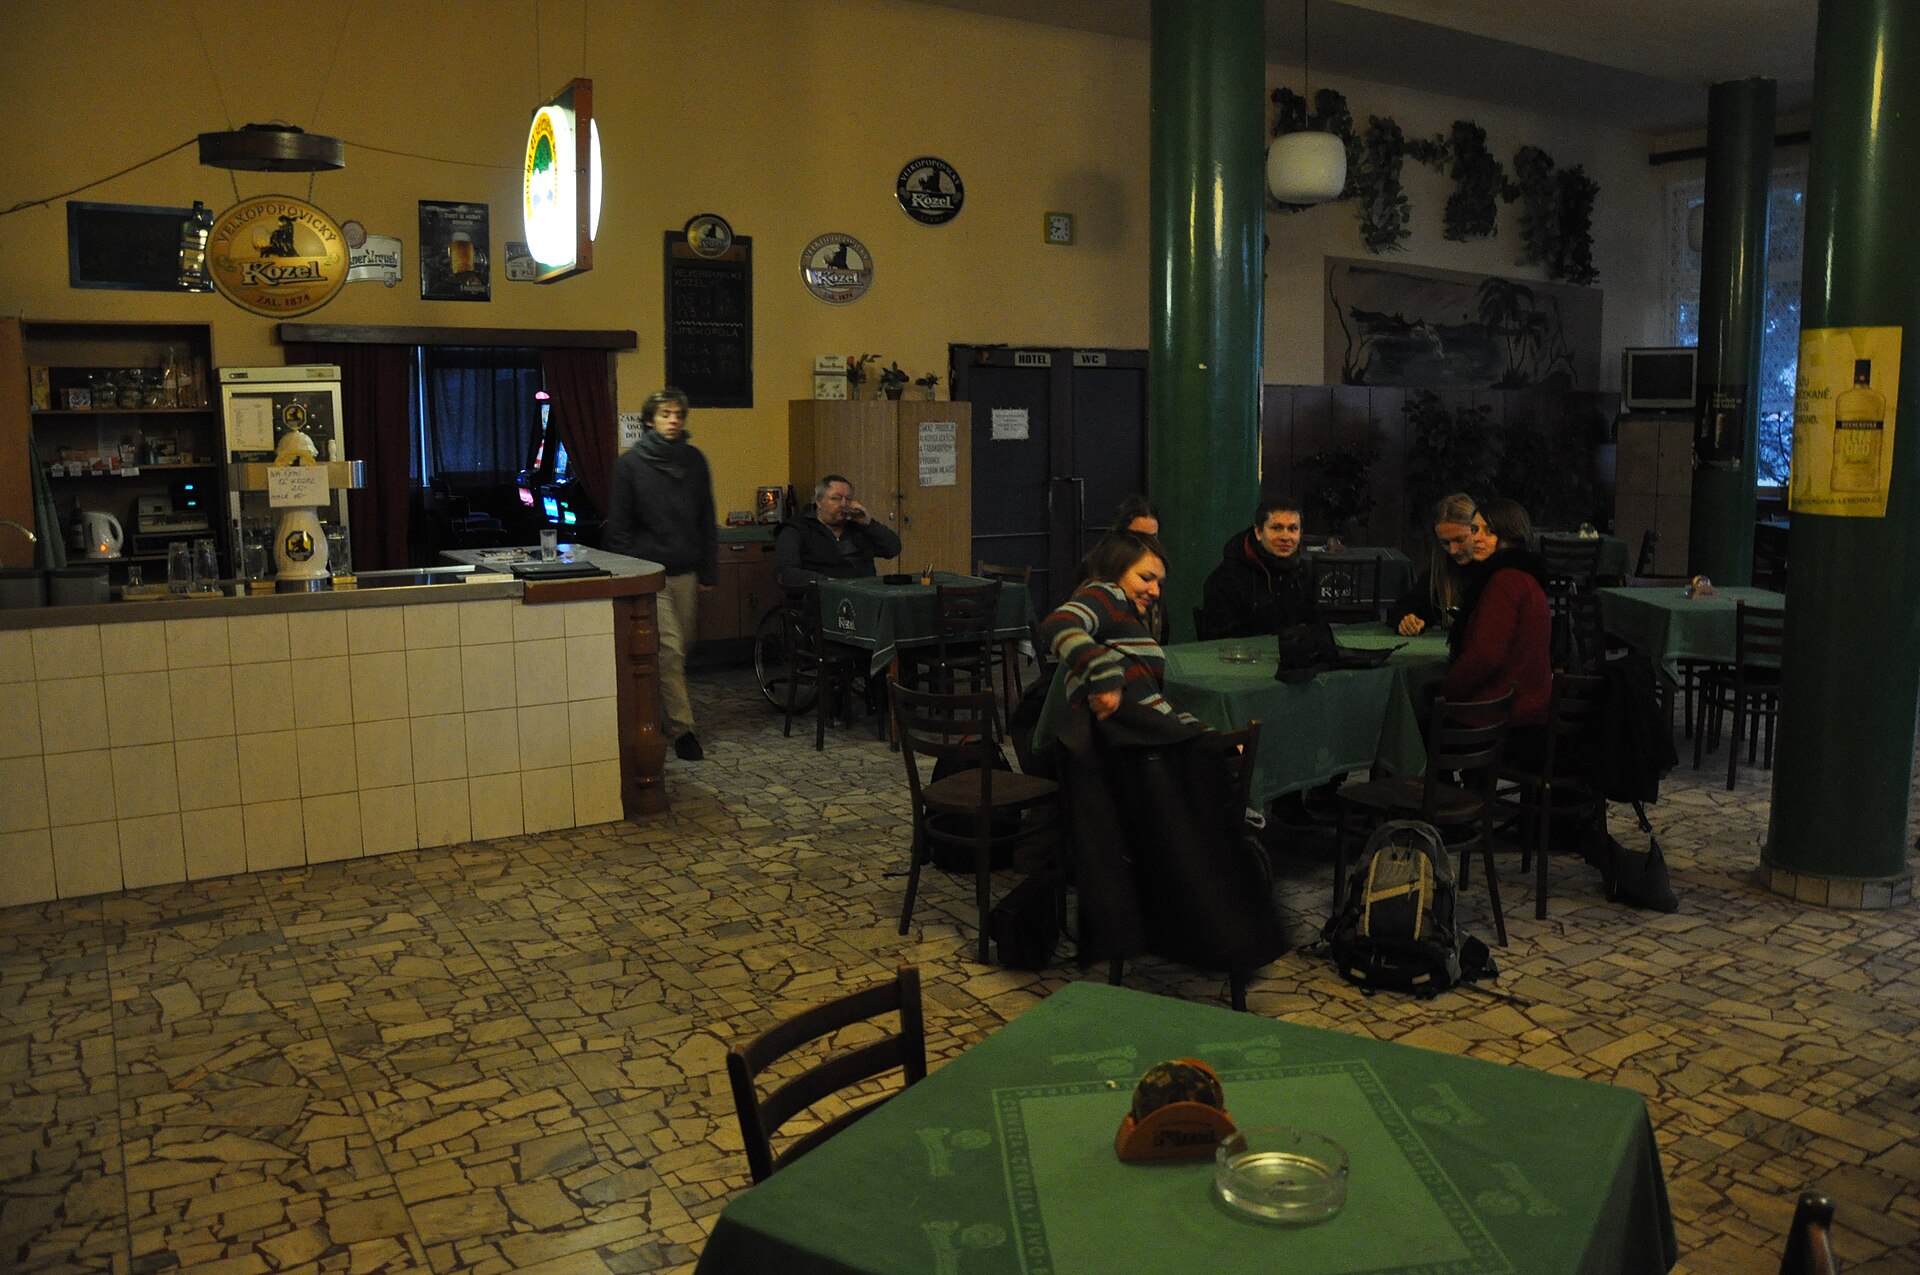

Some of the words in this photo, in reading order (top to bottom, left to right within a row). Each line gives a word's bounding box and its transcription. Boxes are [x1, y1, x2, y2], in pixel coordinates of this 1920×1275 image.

[911, 192, 956, 209] Kozel
[241, 261, 328, 287] Kozel
[815, 271, 864, 288] Kozel
[285, 294, 310, 306] 1874
[1018, 354, 1047, 364] HOTEL
[1081, 354, 1099, 364] WC
